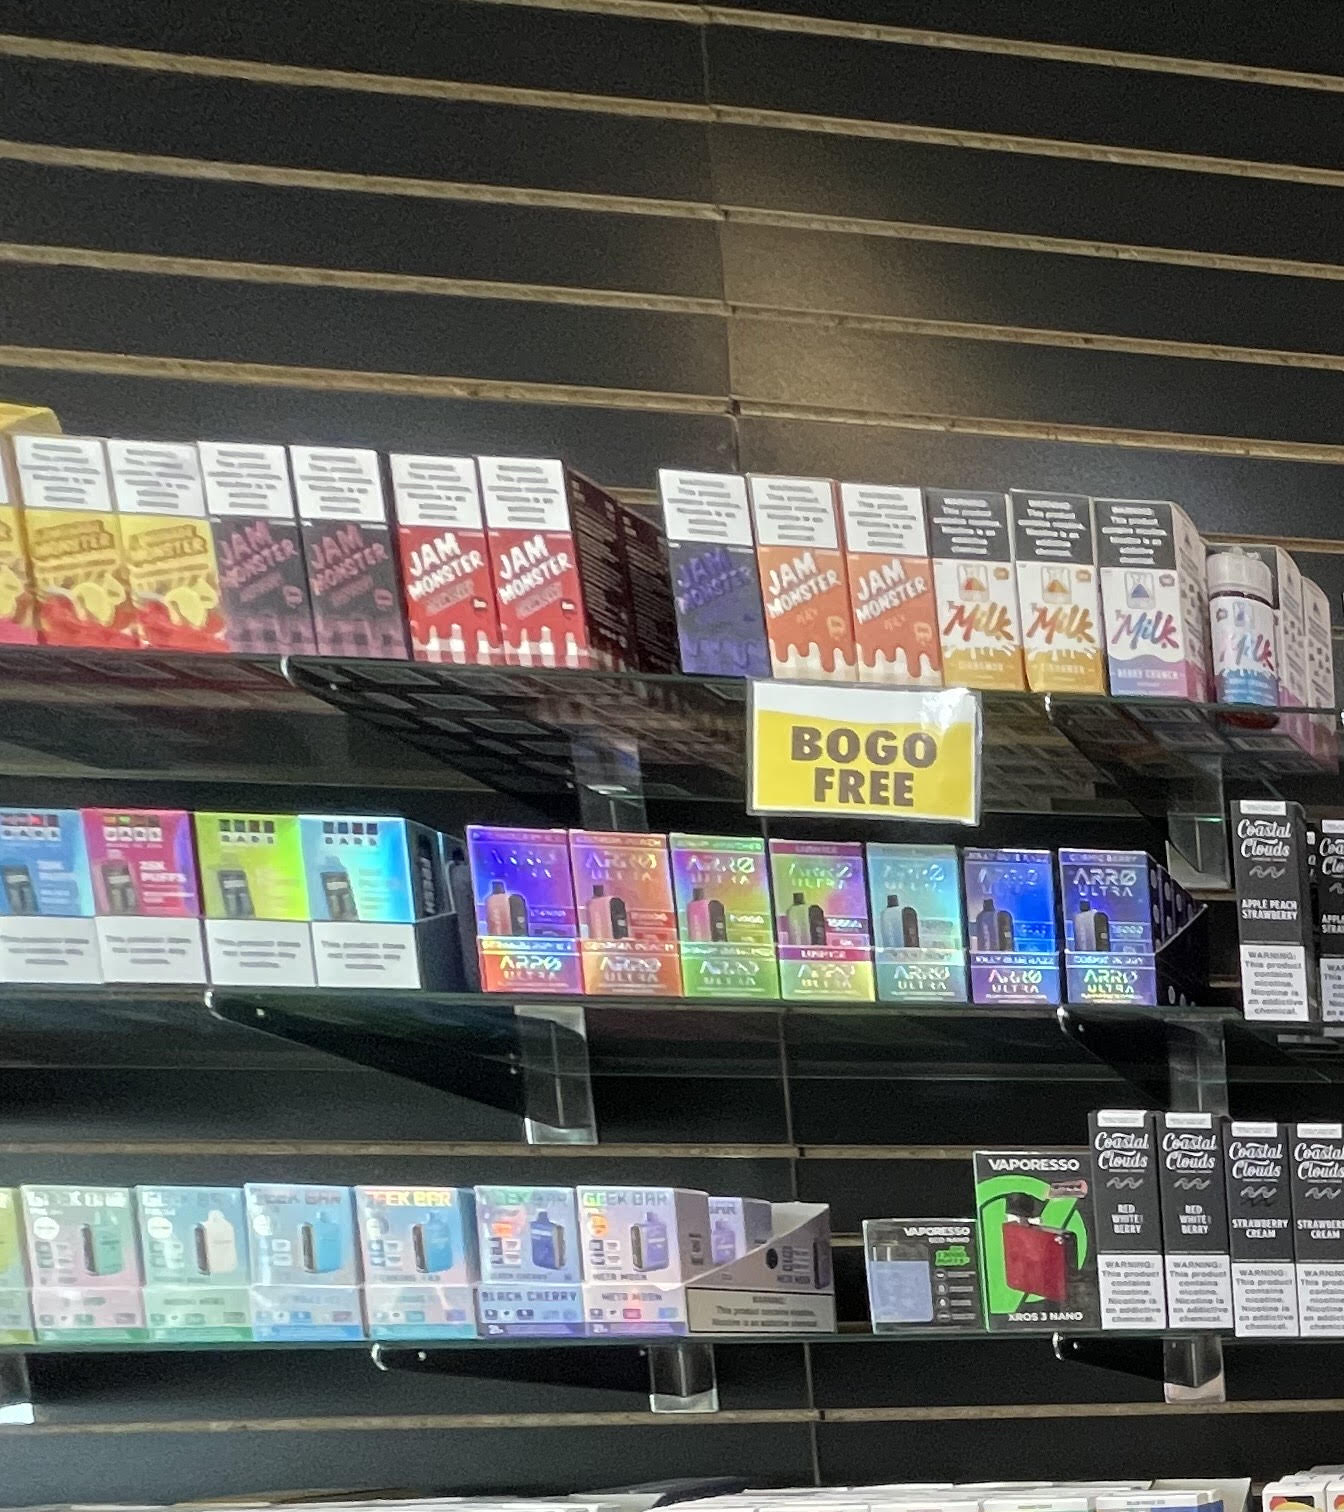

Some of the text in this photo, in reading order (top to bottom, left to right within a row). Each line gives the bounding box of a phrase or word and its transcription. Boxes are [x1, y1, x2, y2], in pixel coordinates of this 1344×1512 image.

[410, 532, 461, 577] JAM
[500, 535, 549, 580] JAM
[407, 550, 484, 601] MONSTER
[497, 553, 573, 604] MONSTER
[769, 552, 818, 594] JAM
[857, 560, 906, 601] JAM
[766, 570, 842, 618] MONSTER
[856, 578, 928, 623] MONSTER
[943, 602, 1014, 642] Milk
[1026, 604, 1096, 644] Milk
[1111, 611, 1180, 649] Milk
[790, 726, 937, 768] BOGO
[813, 768, 915, 806] FREE
[1237, 819, 1291, 839] Coastal
[1240, 838, 1290, 859] Clouds
[1241, 899, 1297, 909] APPLE PEACH
[1094, 1131, 1149, 1151] Coastal
[1228, 1141, 1283, 1161] Coastal
[988, 1158, 1080, 1171] VAPORESSO
[1098, 1150, 1148, 1170] Clouds
[1232, 1160, 1281, 1179] Clouds
[904, 1227, 970, 1236] VAPORESSO
[1232, 1219, 1288, 1229] STRAWBERRY
[1245, 1229, 1276, 1239] CREAM
[527, 1291, 577, 1301] CHERRY
[1008, 1313, 1038, 1322] XROS
[1050, 1312, 1083, 1321] NANO
